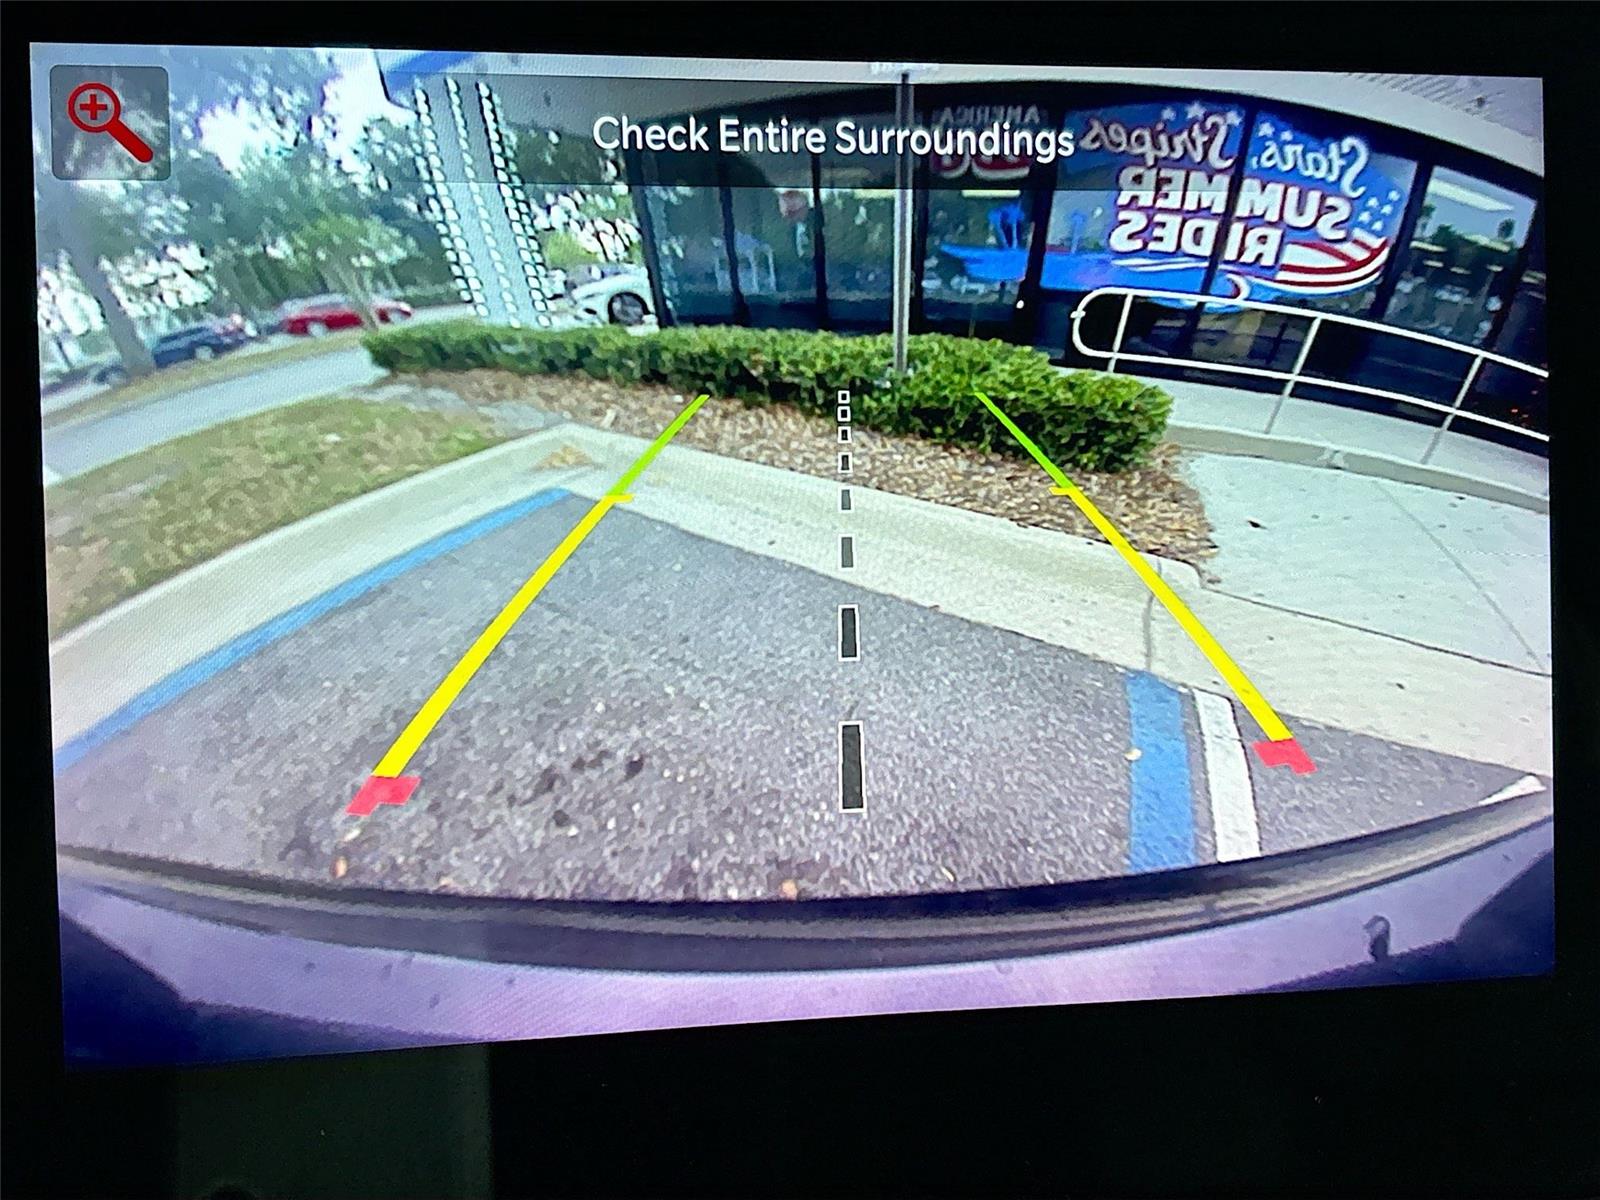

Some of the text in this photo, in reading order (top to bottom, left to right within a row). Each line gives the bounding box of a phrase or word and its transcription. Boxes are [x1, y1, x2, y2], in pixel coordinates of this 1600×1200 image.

[593, 115, 710, 151] Check
[719, 117, 826, 154] Entire
[835, 120, 1074, 164] Surroundings
